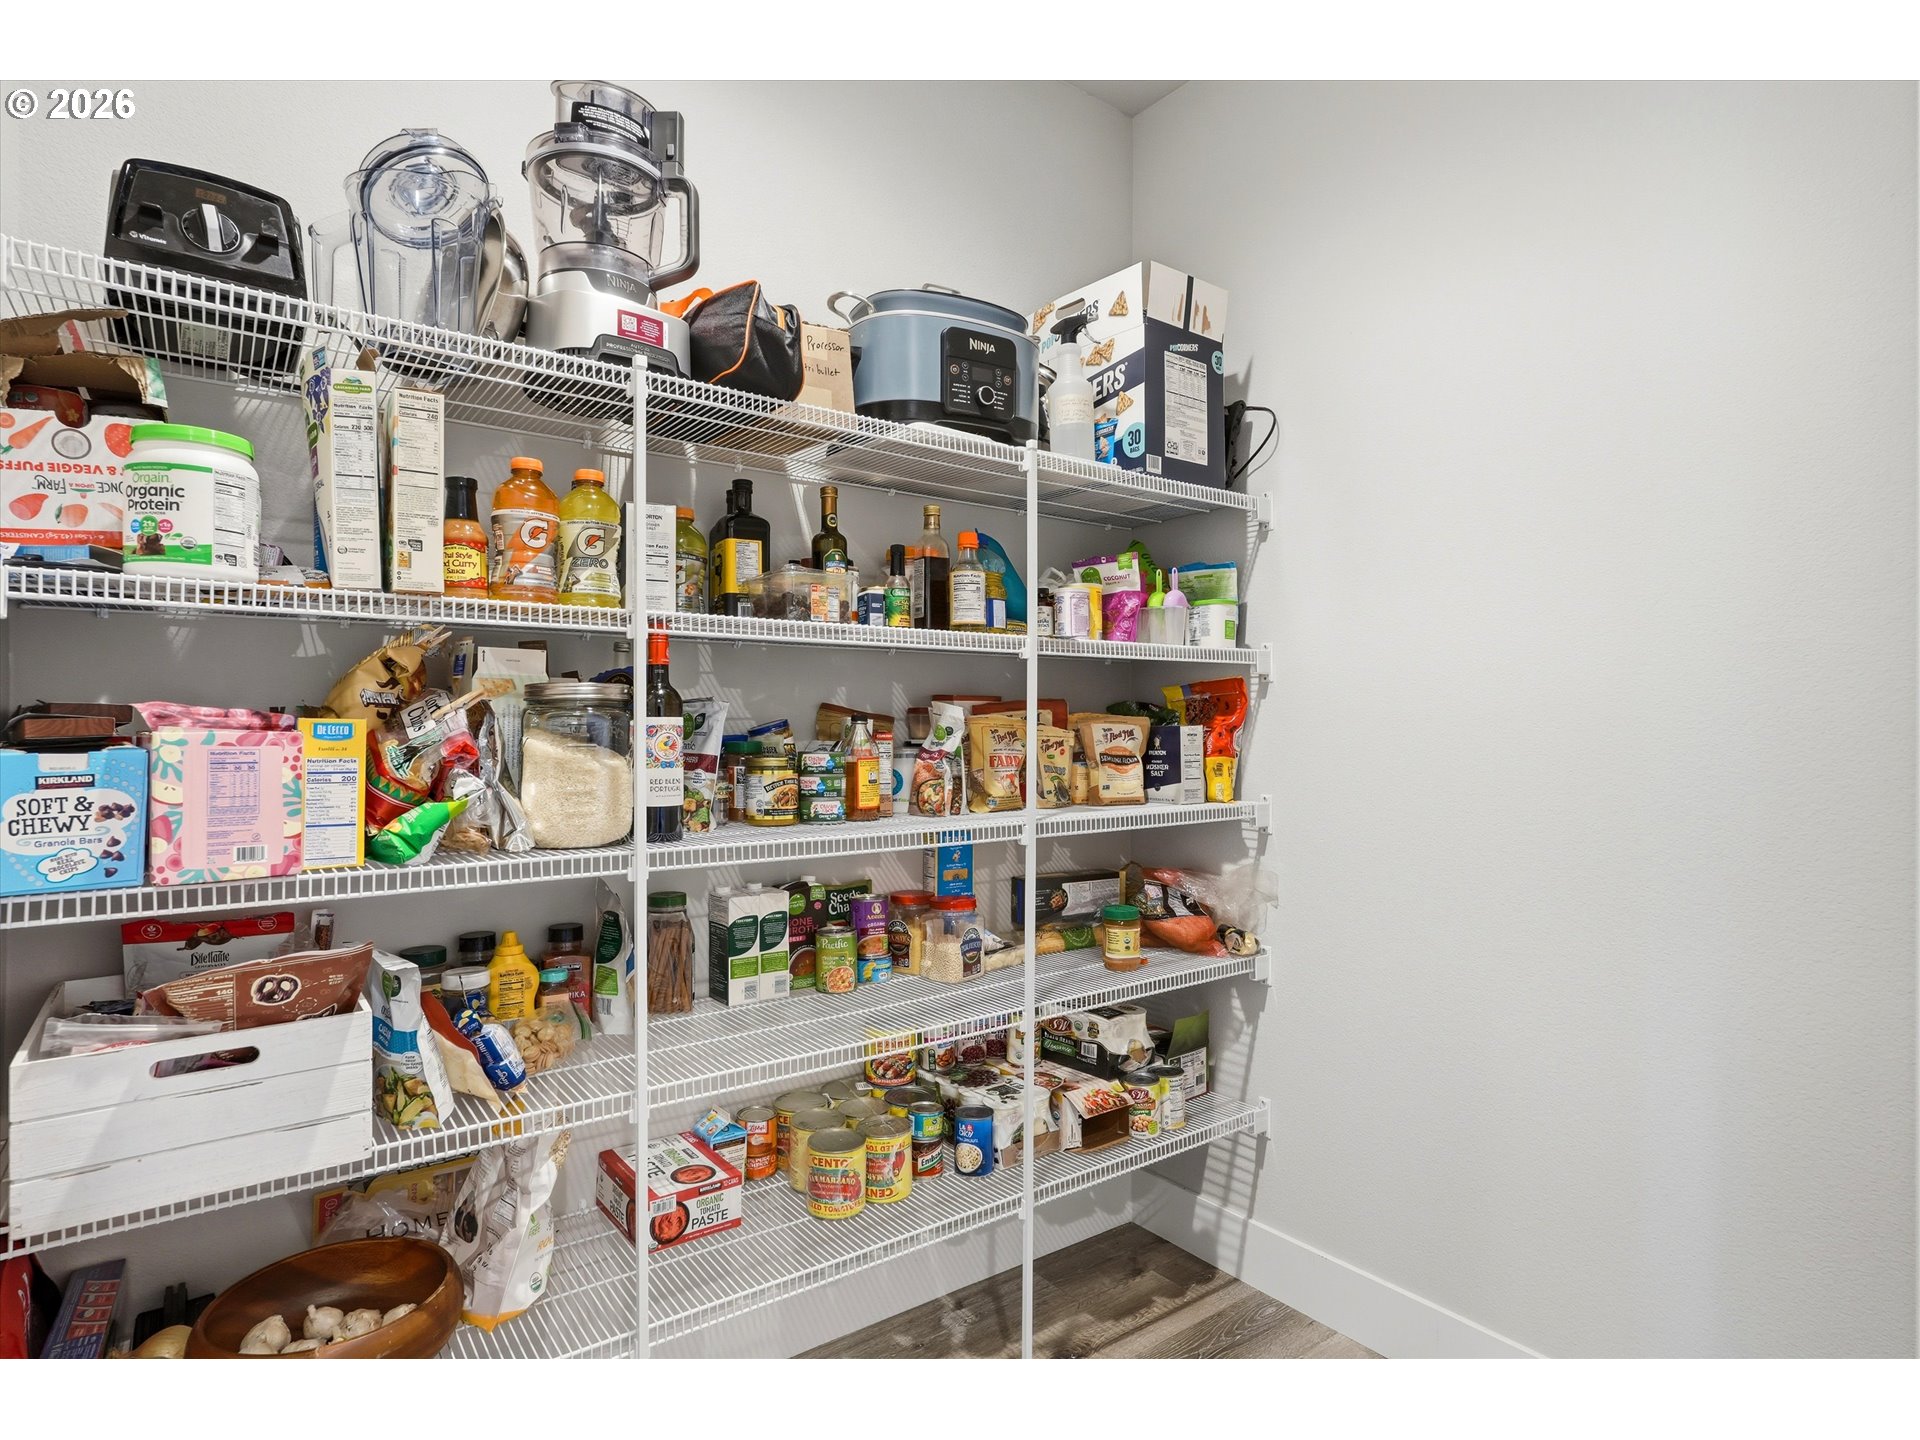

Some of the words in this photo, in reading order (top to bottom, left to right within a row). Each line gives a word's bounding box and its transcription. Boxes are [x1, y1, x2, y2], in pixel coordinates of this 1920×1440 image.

[606, 273, 637, 293] NINJA
[807, 335, 844, 351] Processor
[969, 337, 996, 354] NINJA
[399, 393, 422, 401] Nutrition
[1128, 428, 1142, 446] 30
[47, 463, 104, 475] VEGGIE
[132, 472, 170, 485] Orgain
[125, 484, 185, 499] Organic
[128, 498, 180, 511] Protein
[577, 526, 606, 557] G
[455, 551, 473, 560] Style
[452, 559, 477, 569] Curry
[571, 556, 609, 569] ZERO
[1103, 573, 1131, 582] COCONUT
[327, 725, 349, 735] CECCO
[38, 775, 93, 785] KIRKLAND
[16, 797, 68, 817] SOFT
[74, 796, 95, 812] &
[8, 815, 92, 836] CHEWY
[34, 839, 76, 848] Granola
[79, 837, 103, 845] Bars
[828, 903, 850, 915] Cha
[788, 917, 813, 926] ONE
[788, 924, 819, 934] ROTH
[821, 938, 849, 949] Pacific
[811, 1156, 849, 1168] CENTO
[865, 1188, 894, 1198] CENT
[696, 1192, 725, 1209] ORGANIC
[699, 1203, 721, 1215] TOMATO
[366, 1211, 449, 1238] HOME
[691, 1208, 729, 1230] PASTE
